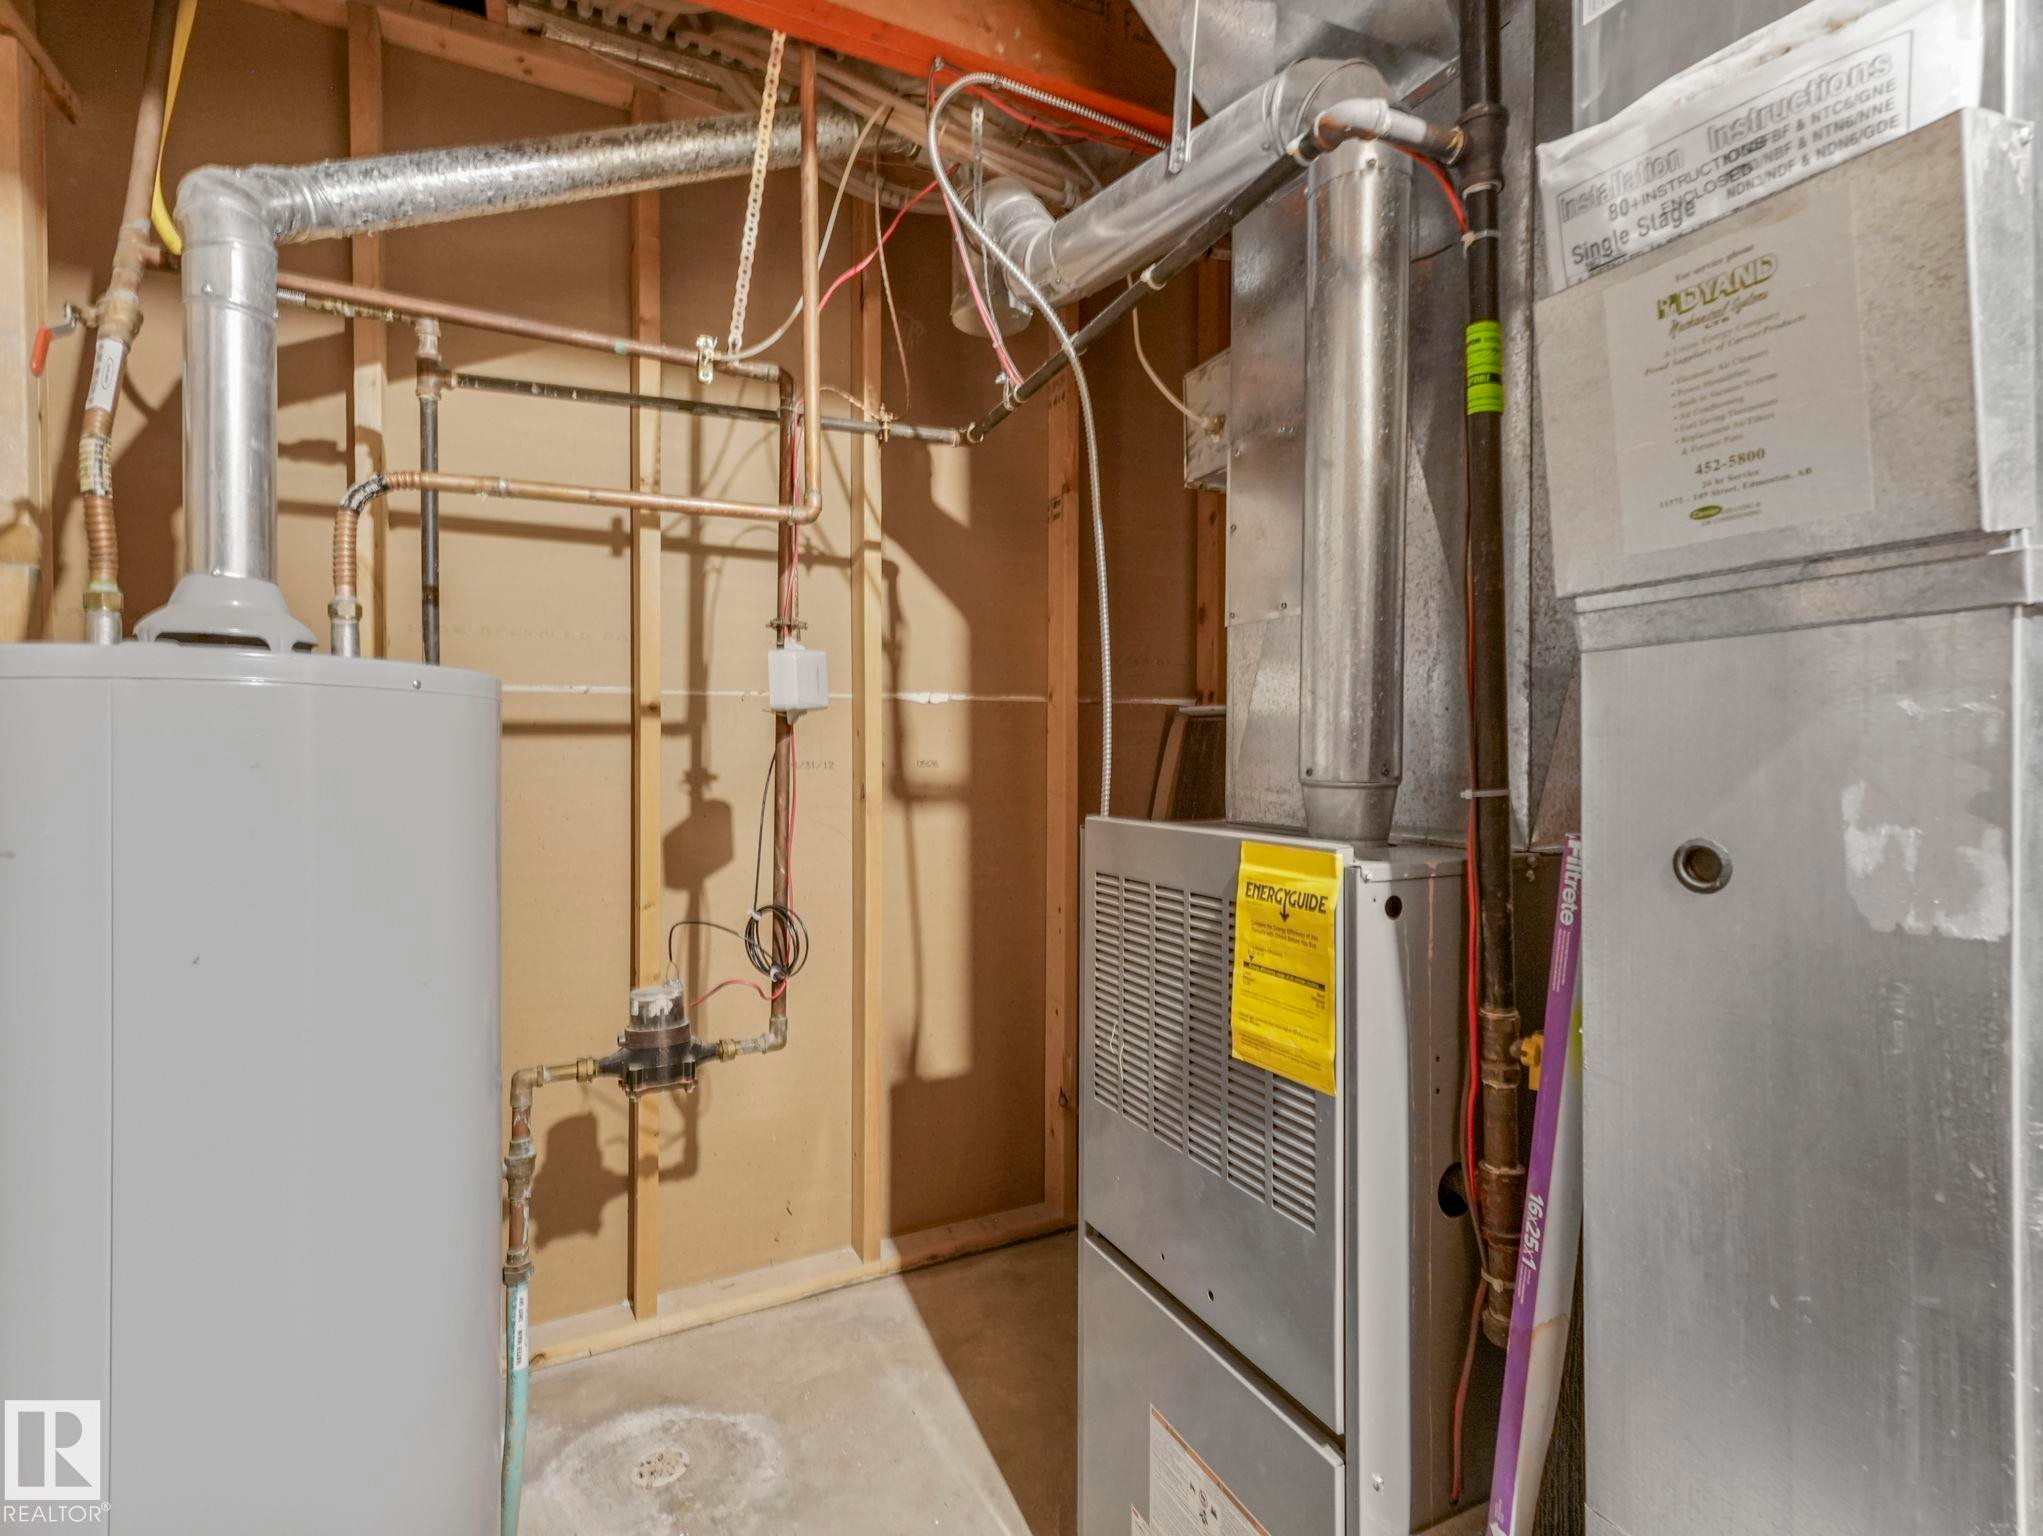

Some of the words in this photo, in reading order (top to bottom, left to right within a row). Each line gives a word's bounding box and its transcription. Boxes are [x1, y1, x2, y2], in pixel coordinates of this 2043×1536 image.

[1560, 148, 1685, 223] Installation
[1706, 52, 1893, 153] Instructions
[1572, 229, 1630, 265] Single
[1636, 200, 1696, 237] Stage
[1694, 447, 1766, 475] 452-5800
[1245, 881, 1328, 915] ENERGYGUIDE
[1560, 839, 1582, 926] Filtrete
[1522, 1193, 1544, 1271] 16x25x1
